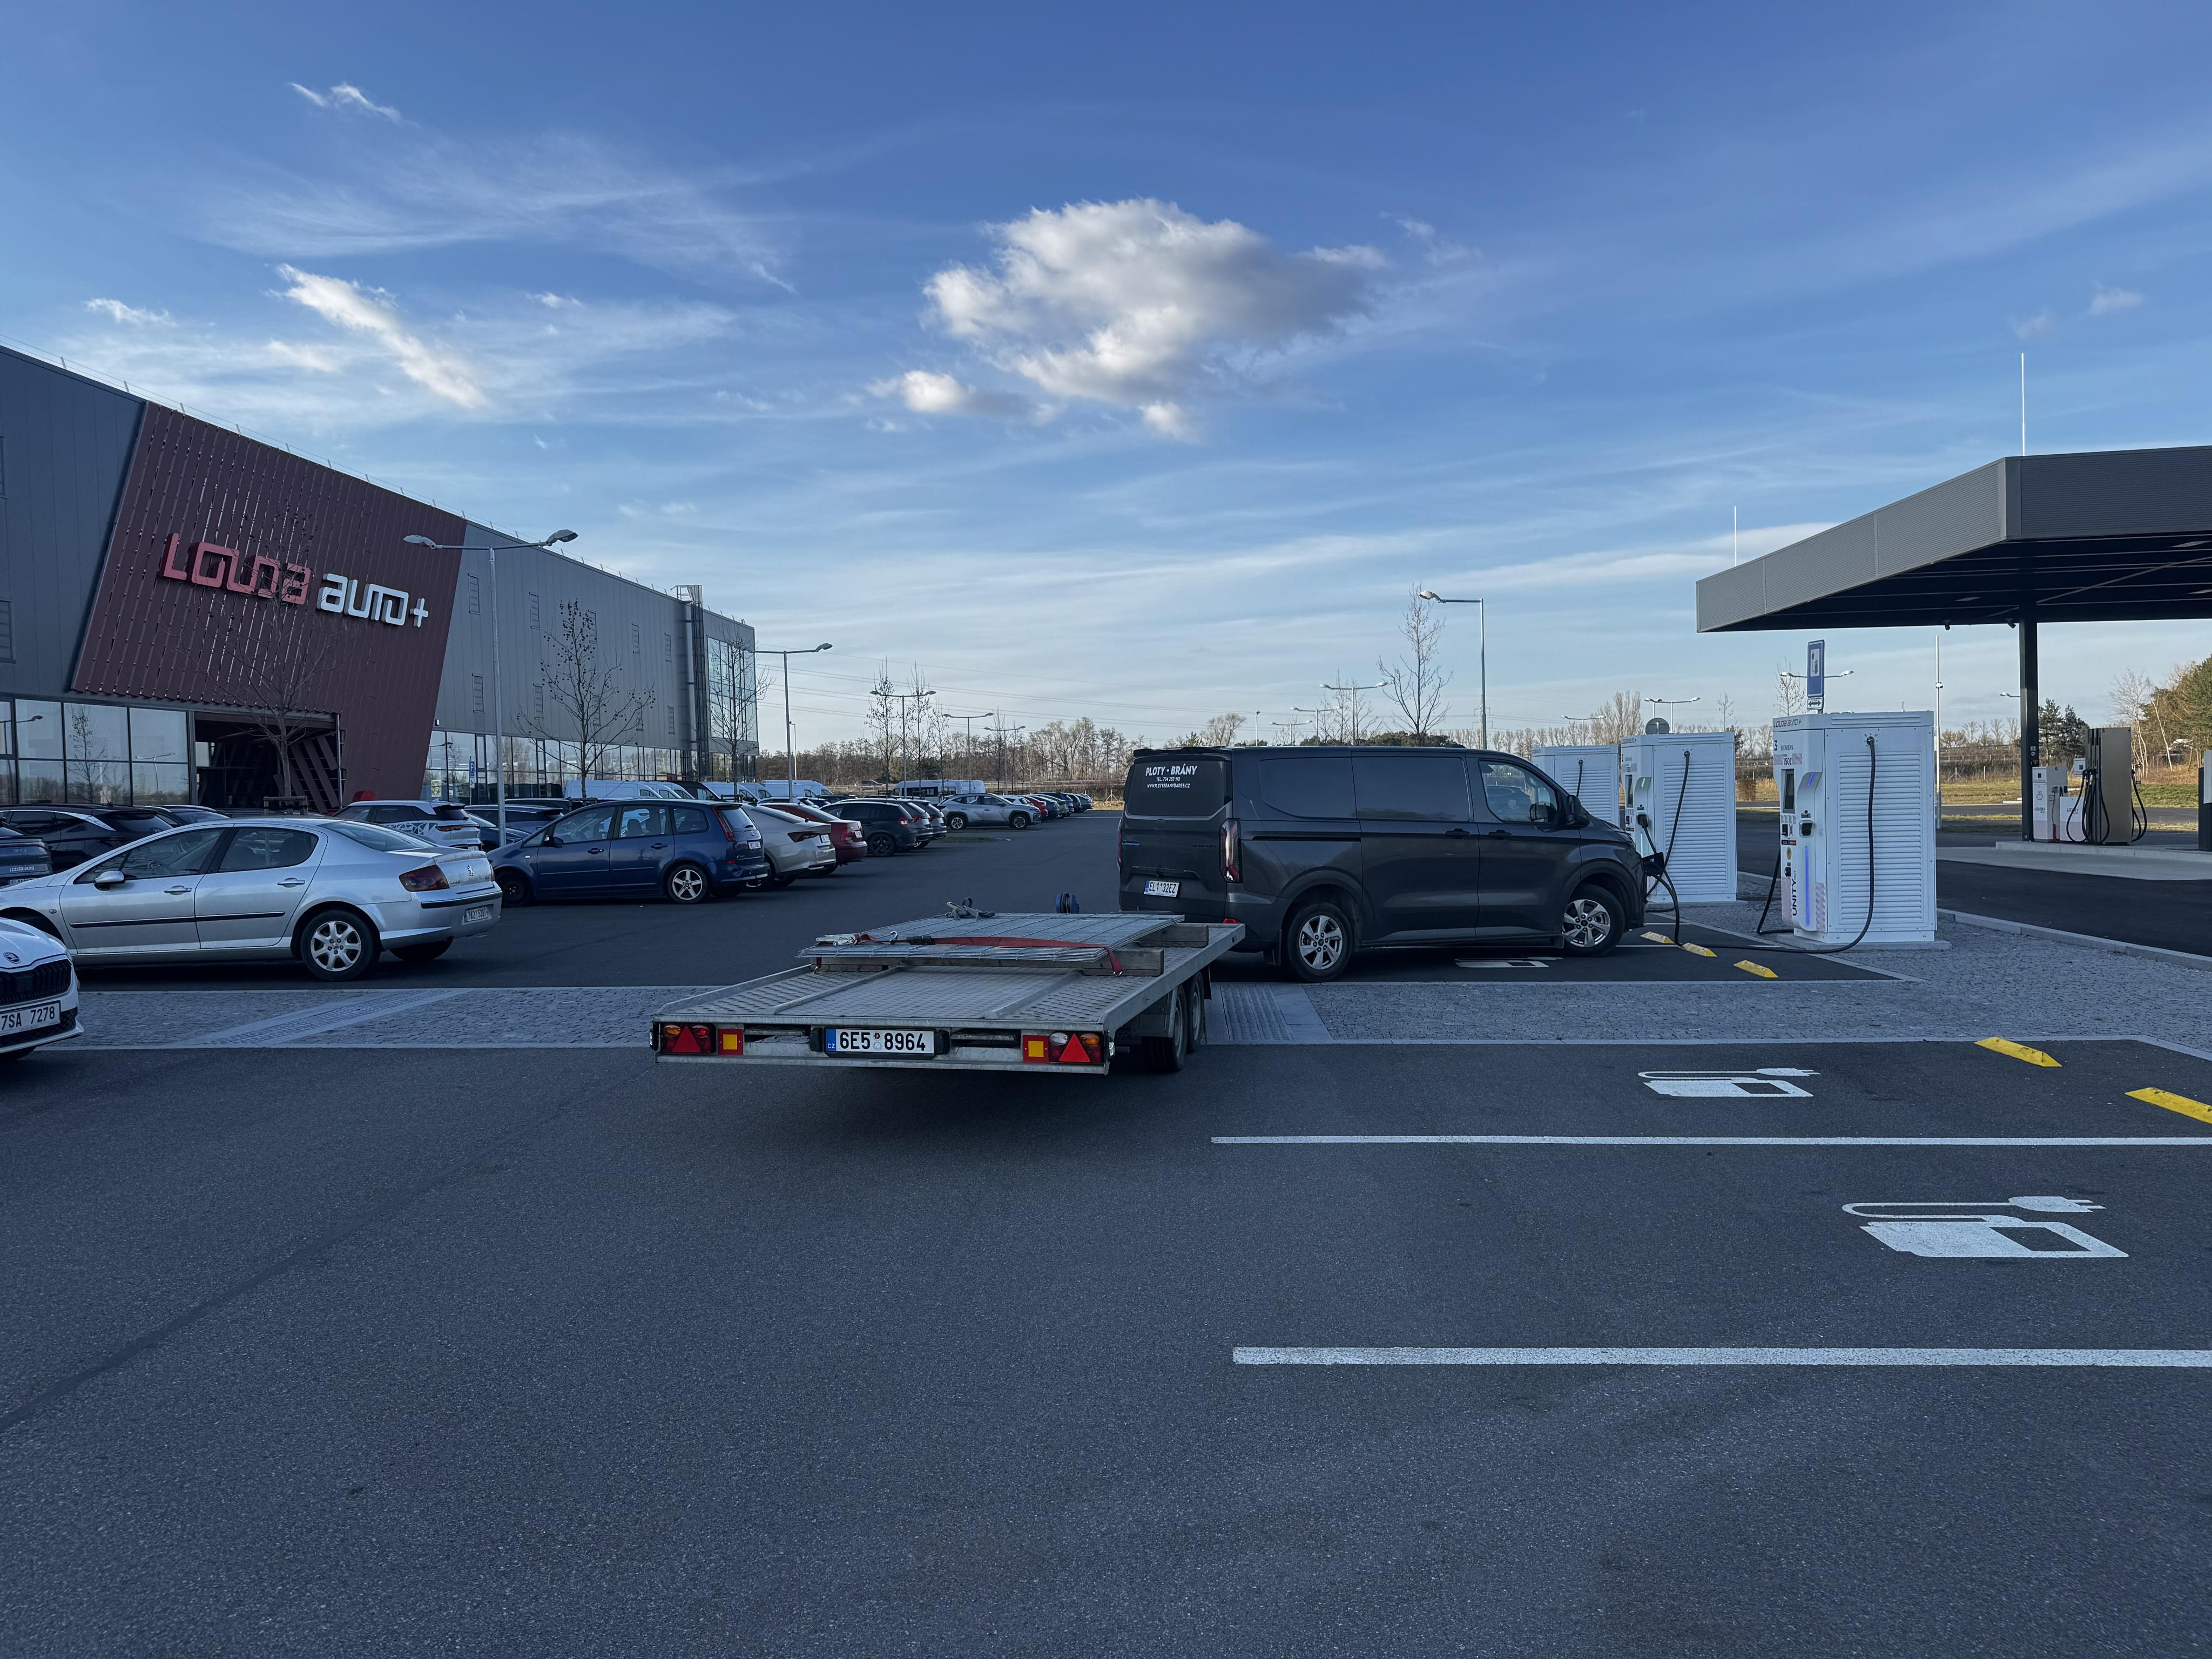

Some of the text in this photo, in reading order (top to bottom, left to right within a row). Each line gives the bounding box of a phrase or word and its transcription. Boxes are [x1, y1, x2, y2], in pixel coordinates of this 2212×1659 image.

[1774, 740, 1778, 751] 3
[1145, 763, 1197, 776] PLOTY BRÁNY
[1, 1006, 55, 1030] 7SA 7278
[840, 1031, 871, 1049] 6E5
[884, 1032, 926, 1051] 8964
